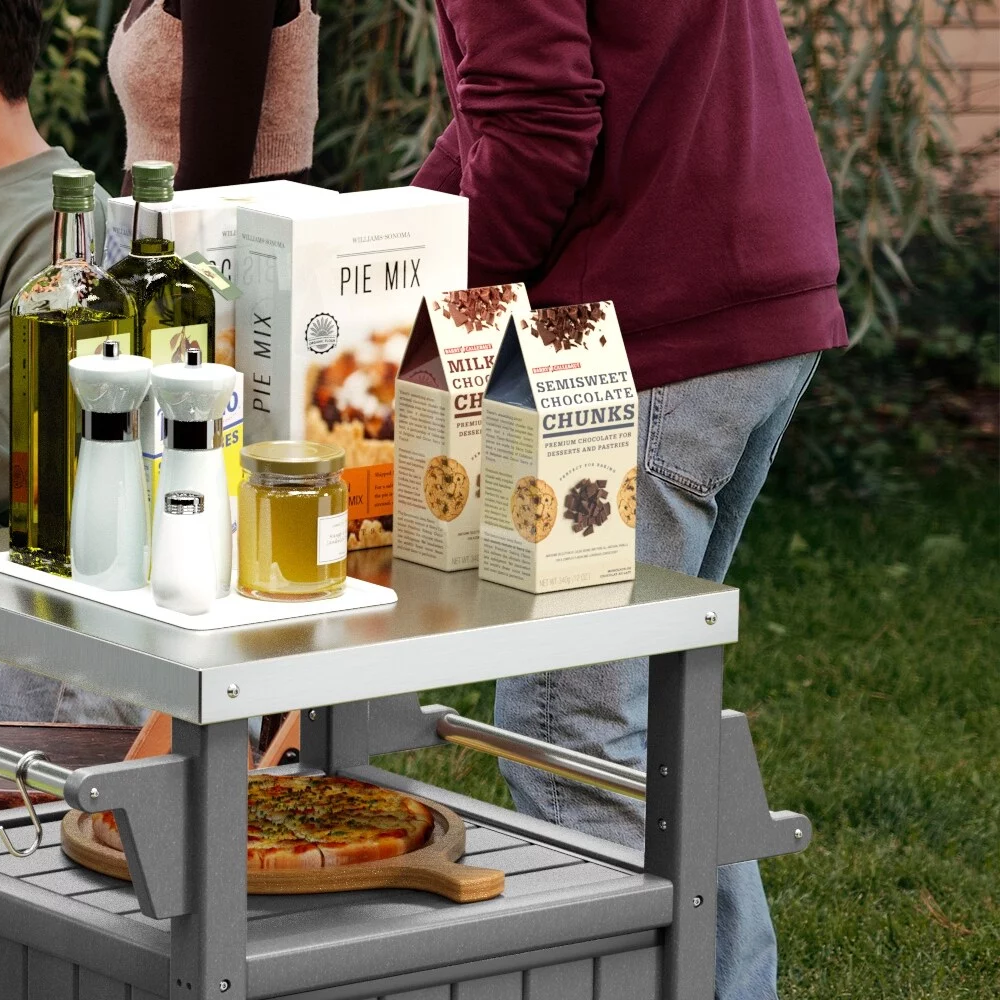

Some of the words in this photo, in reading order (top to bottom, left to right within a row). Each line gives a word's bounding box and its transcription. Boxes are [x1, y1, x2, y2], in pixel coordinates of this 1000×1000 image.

[341, 264, 372, 296] PIE
[385, 258, 421, 291] MIX
[253, 312, 272, 359] MIX
[447, 355, 495, 373] MILK
[253, 372, 271, 414] PIE
[536, 371, 628, 393] SEMISWEET
[540, 387, 634, 409] CHOCOLATE
[543, 403, 635, 431] CHUNKS
[544, 439, 577, 449] PREMIUM
[577, 434, 617, 444] CHOCOLATE
[547, 448, 580, 457] DESSERTS
[582, 445, 597, 453] AND
[597, 441, 630, 451] PASTRIES
